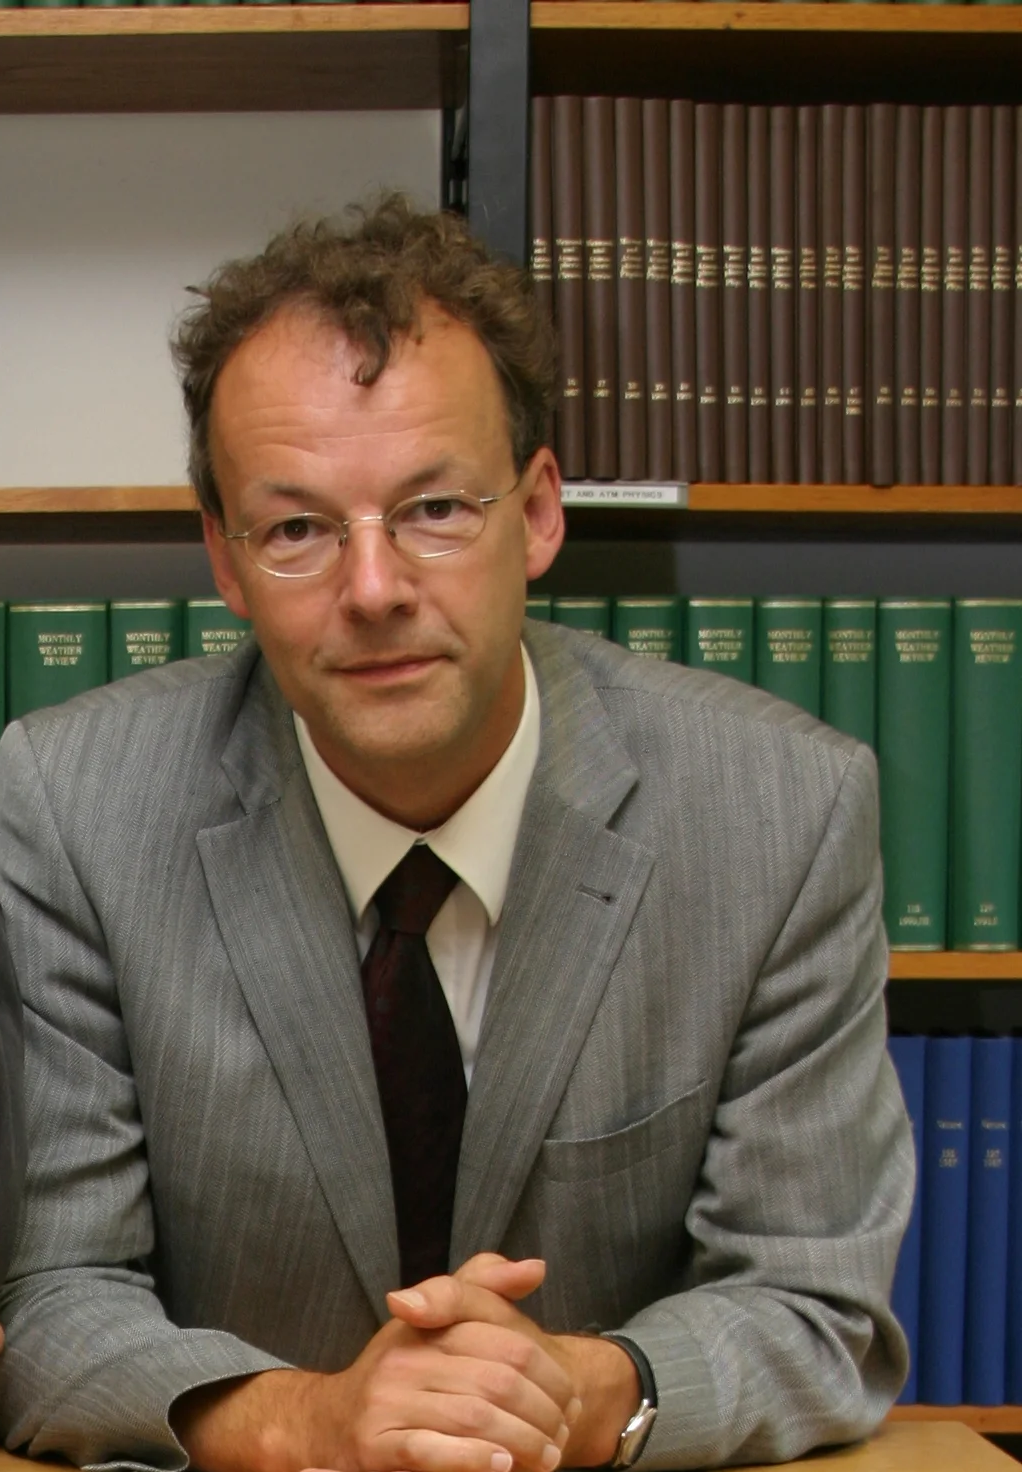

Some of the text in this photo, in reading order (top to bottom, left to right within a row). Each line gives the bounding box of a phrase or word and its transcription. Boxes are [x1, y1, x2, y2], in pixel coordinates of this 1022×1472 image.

[576, 491, 594, 499] AND
[622, 491, 663, 499] PHYSICS
[38, 633, 82, 644] MONTHLY
[125, 632, 170, 643] MONTHLY
[201, 631, 246, 640] MONTHLY
[39, 646, 82, 655] WEATHER
[126, 645, 170, 654] WEATHER
[43, 656, 78, 666] REVIEW
[131, 655, 166, 665] REVIEW
